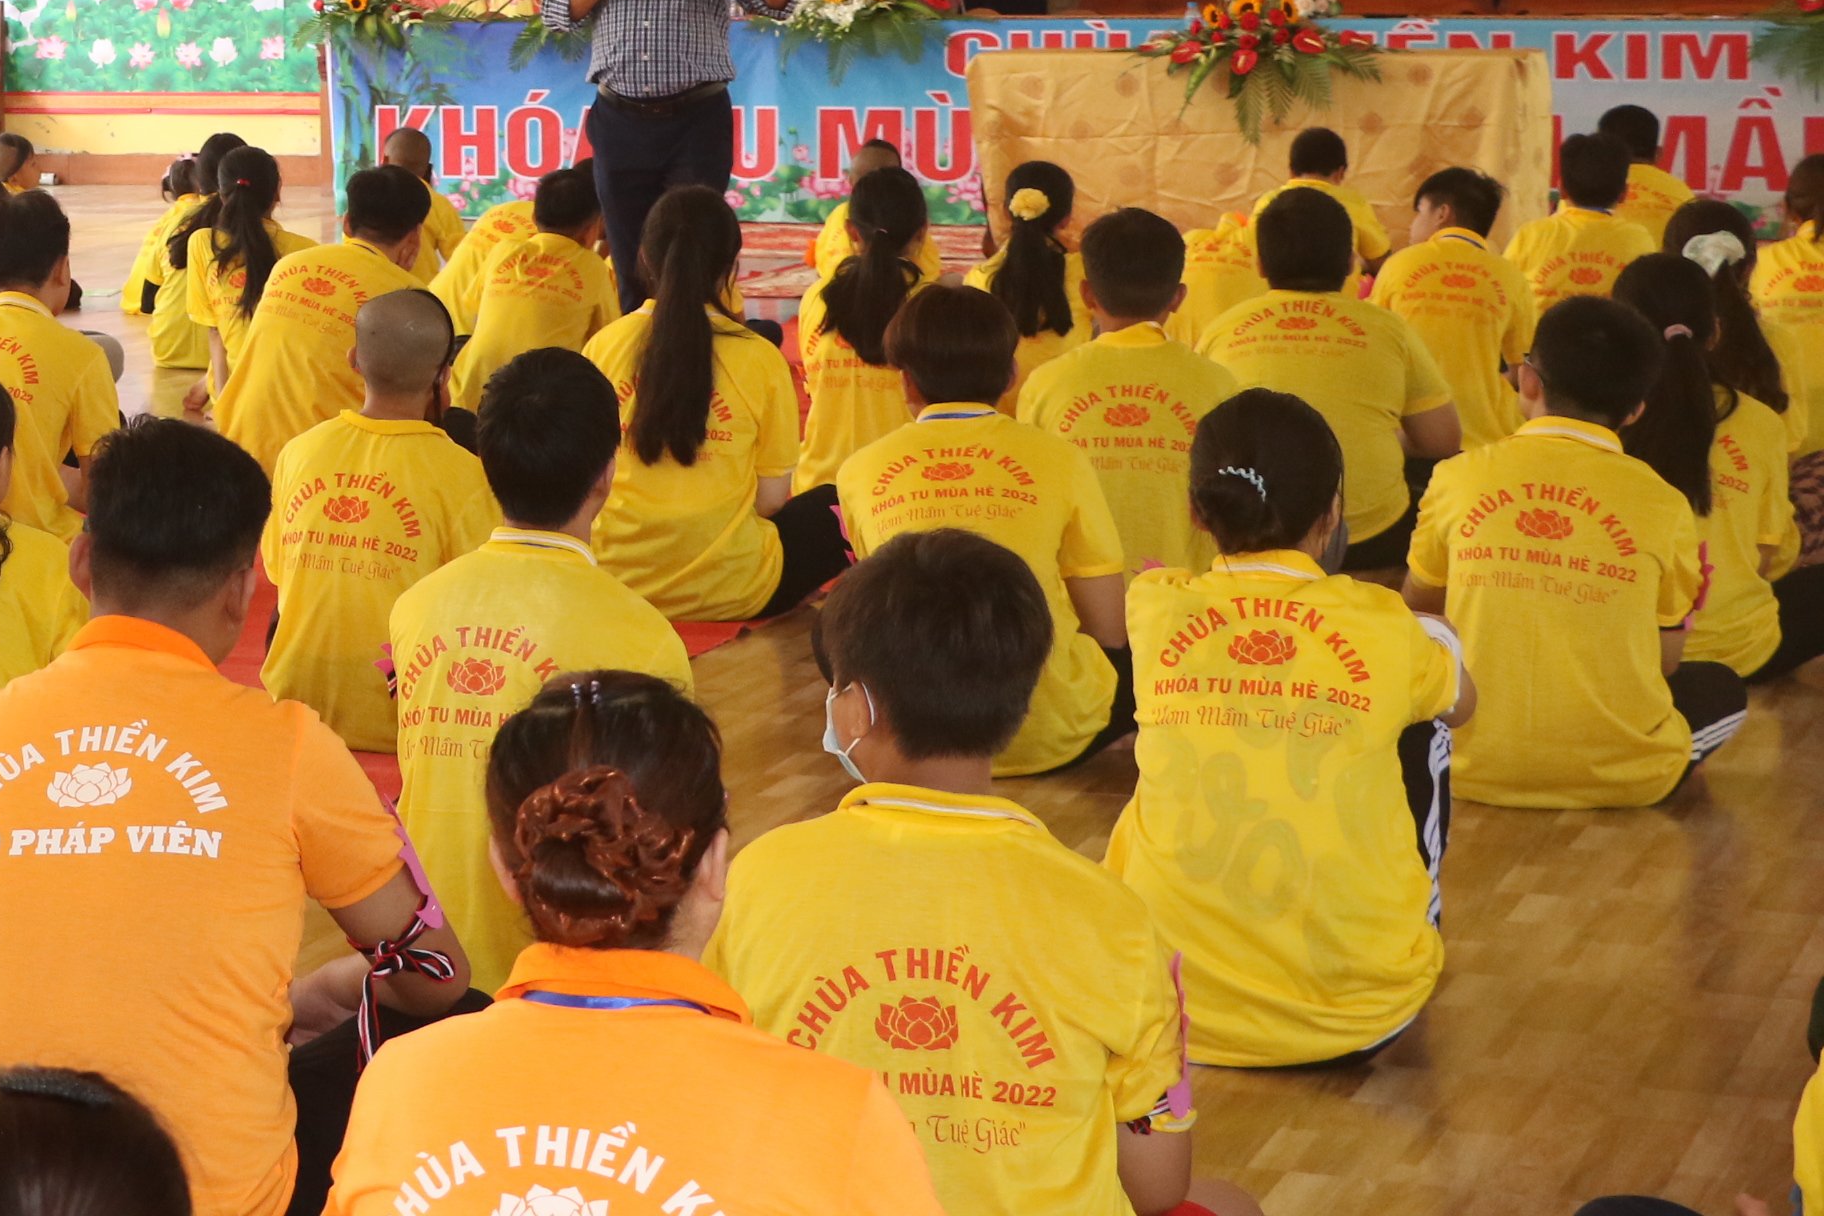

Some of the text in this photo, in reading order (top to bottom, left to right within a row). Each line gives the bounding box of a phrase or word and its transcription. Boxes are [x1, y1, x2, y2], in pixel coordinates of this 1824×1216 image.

[1553, 32, 1752, 81] KIM
[376, 90, 593, 178] KHÓ
[818, 92, 974, 181] MÙ
[17, 353, 40, 385] KIM
[1059, 383, 1170, 433] CHÙA THIỀN
[872, 443, 1035, 497] CHÙA THIỀN KIM
[1718, 434, 1749, 472] KIM
[286, 471, 422, 538] CHÙA THIỀN KIM
[871, 485, 1038, 517] KHÓA TU MÙA HÈ 2022
[1460, 482, 1638, 557] CHÙA THIỀN KIM
[307, 530, 418, 563] TU MÙA HÈ 2022
[1499, 546, 1521, 560] TU
[1526, 547, 1562, 567] MÙA
[1568, 555, 1590, 573] HÈ
[1597, 562, 1637, 583] 2022
[401, 625, 538, 701] CHÙA THIỀN
[1159, 606, 1371, 683] CHÙA KIM
[1154, 672, 1371, 712] KHÓA TU MÙA HÈ 2022
[428, 705, 492, 727] TU MÙA
[1197, 705, 1248, 728] Mầm
[54, 718, 169, 762] THIỀN
[165, 751, 228, 814] KIM
[8, 821, 116, 856] PHÁP
[126, 820, 223, 859] VIÊN
[786, 944, 1056, 1069] CHÙA THIỀN KIM
[899, 1066, 956, 1097] MÙA
[960, 1070, 984, 1100] HÈ
[991, 1080, 1057, 1108] 2022
[926, 1115, 970, 1149] Tuệ
[495, 1121, 666, 1194] THIỀN
